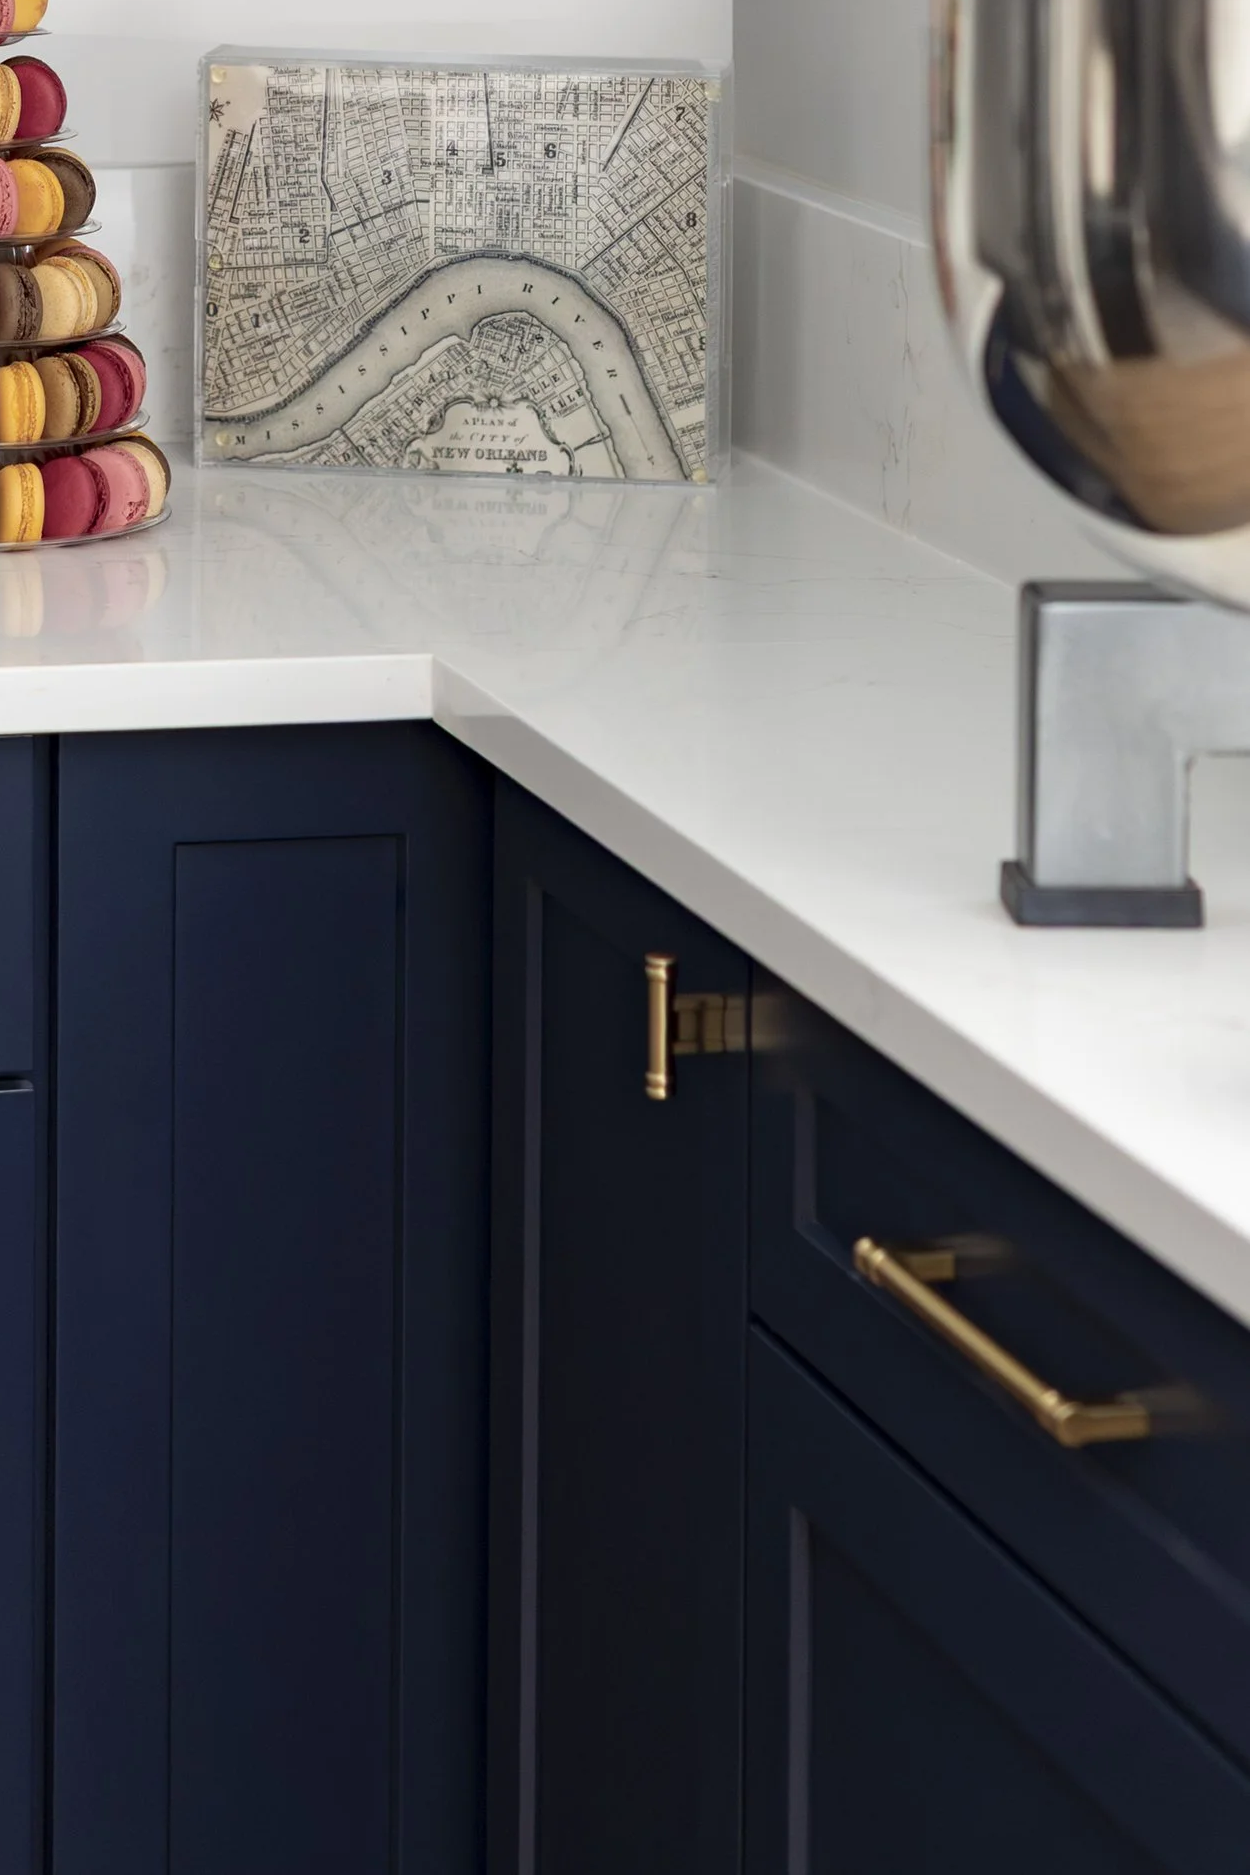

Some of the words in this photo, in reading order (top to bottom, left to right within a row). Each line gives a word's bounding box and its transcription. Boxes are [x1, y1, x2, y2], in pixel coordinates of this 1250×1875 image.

[675, 106, 686, 123] 7
[446, 140, 459, 157] 4
[544, 142, 557, 159] 6
[496, 151, 507, 167] 5
[381, 169, 392, 185] 3
[686, 211, 697, 228] 8
[299, 228, 310, 244] 2
[235, 284, 482, 445] MISSISSIPPI
[522, 282, 618, 379] RIVER
[508, 416, 519, 427] of
[449, 431, 464, 441] the
[470, 432, 511, 443] CITY
[514, 433, 529, 446] of
[431, 446, 471, 460] NEW
[475, 447, 549, 462] ORLEANS
